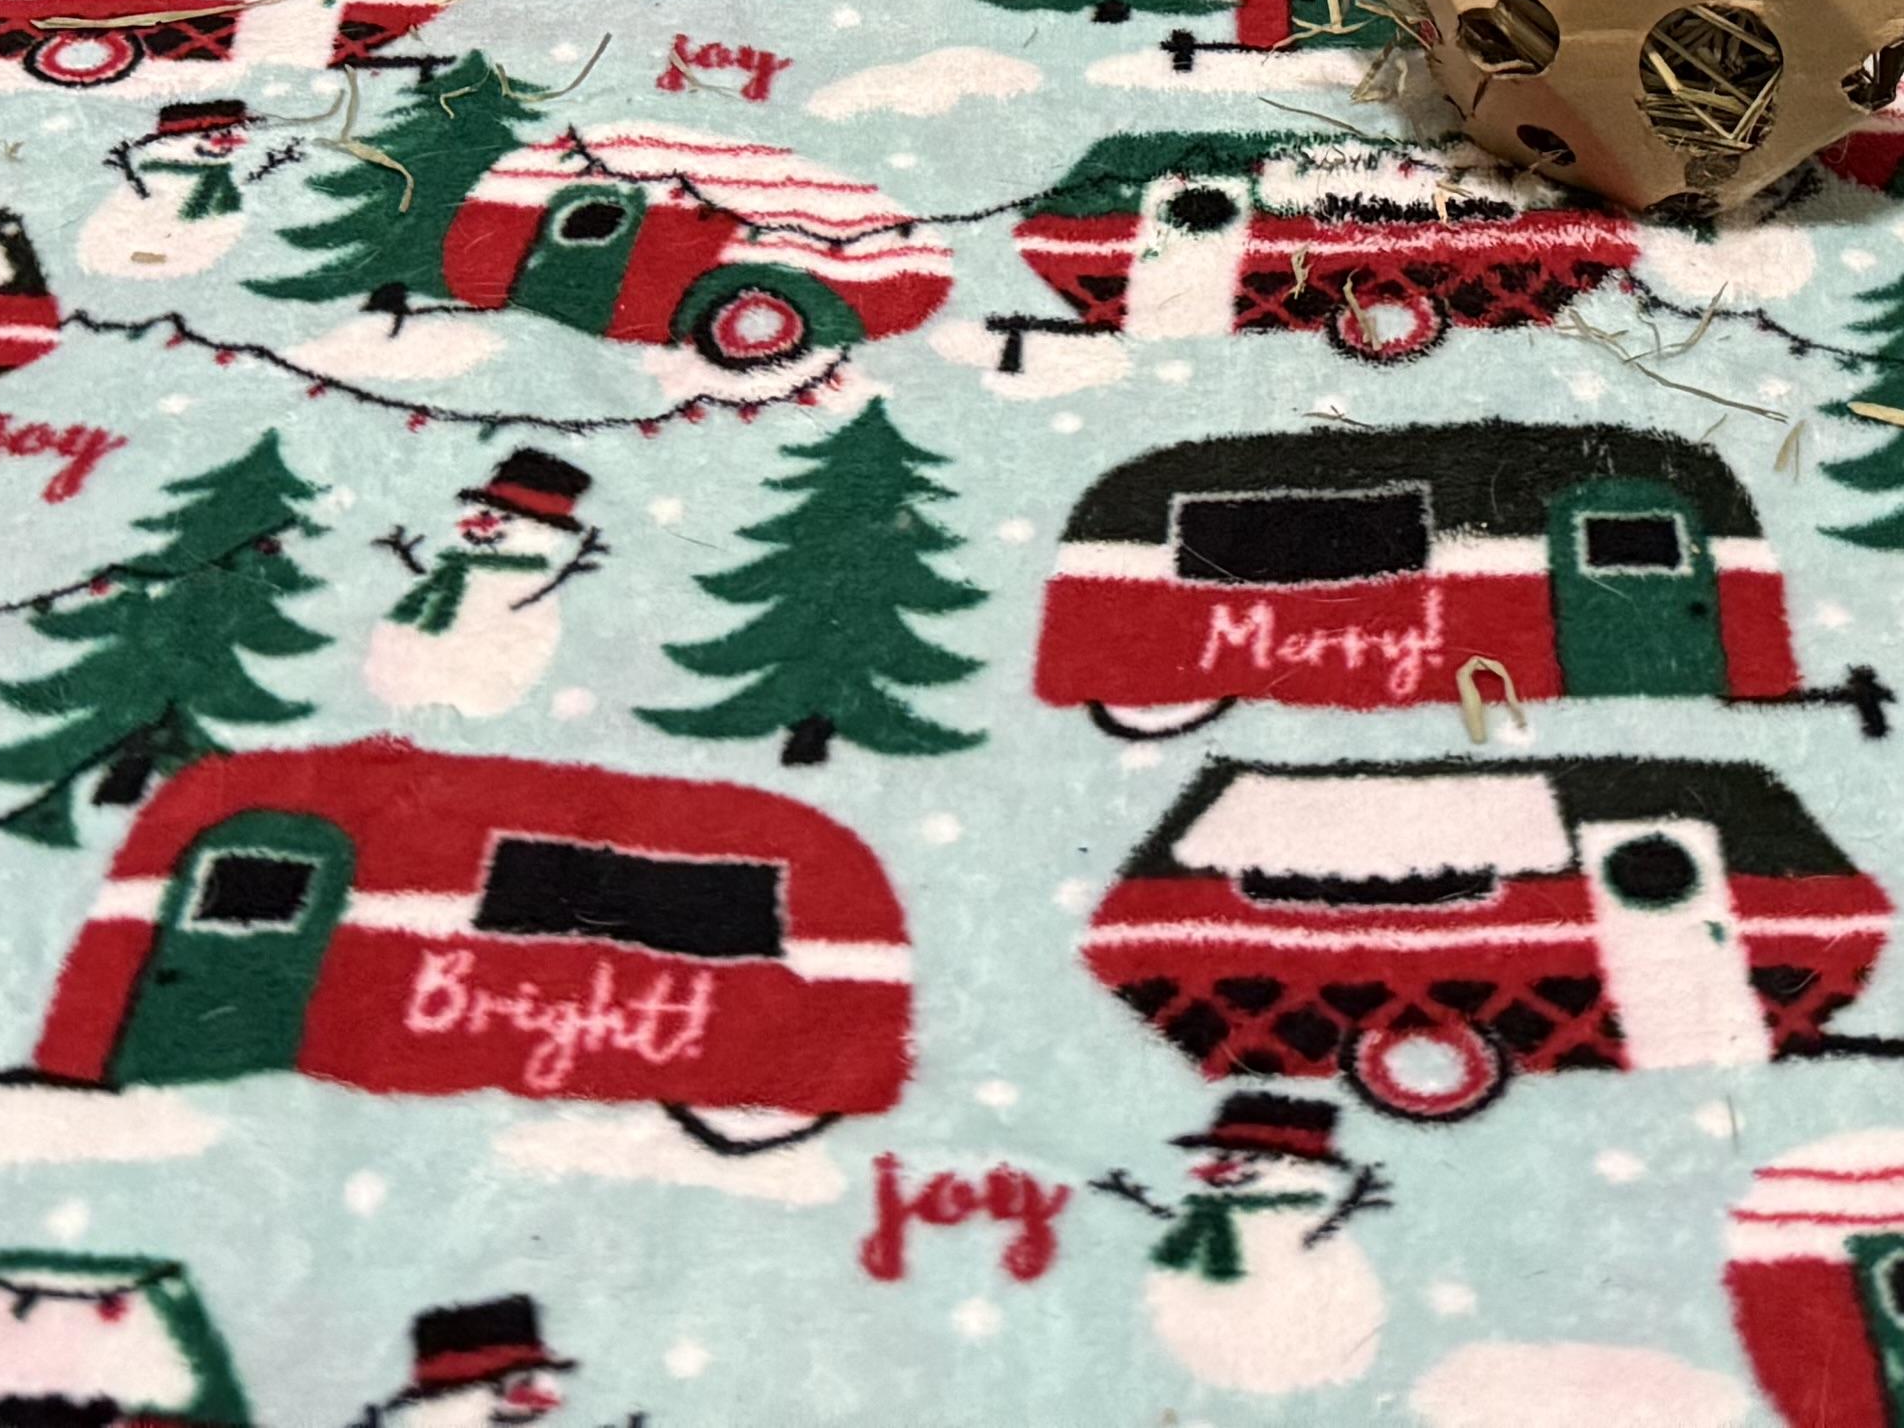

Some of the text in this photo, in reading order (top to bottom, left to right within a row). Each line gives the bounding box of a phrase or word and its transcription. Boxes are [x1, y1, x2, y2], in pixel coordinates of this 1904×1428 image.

[656, 34, 793, 101] joy
[1199, 586, 1444, 694] Merry!
[403, 948, 715, 1090] Bright!
[861, 1148, 1075, 1281] joy
